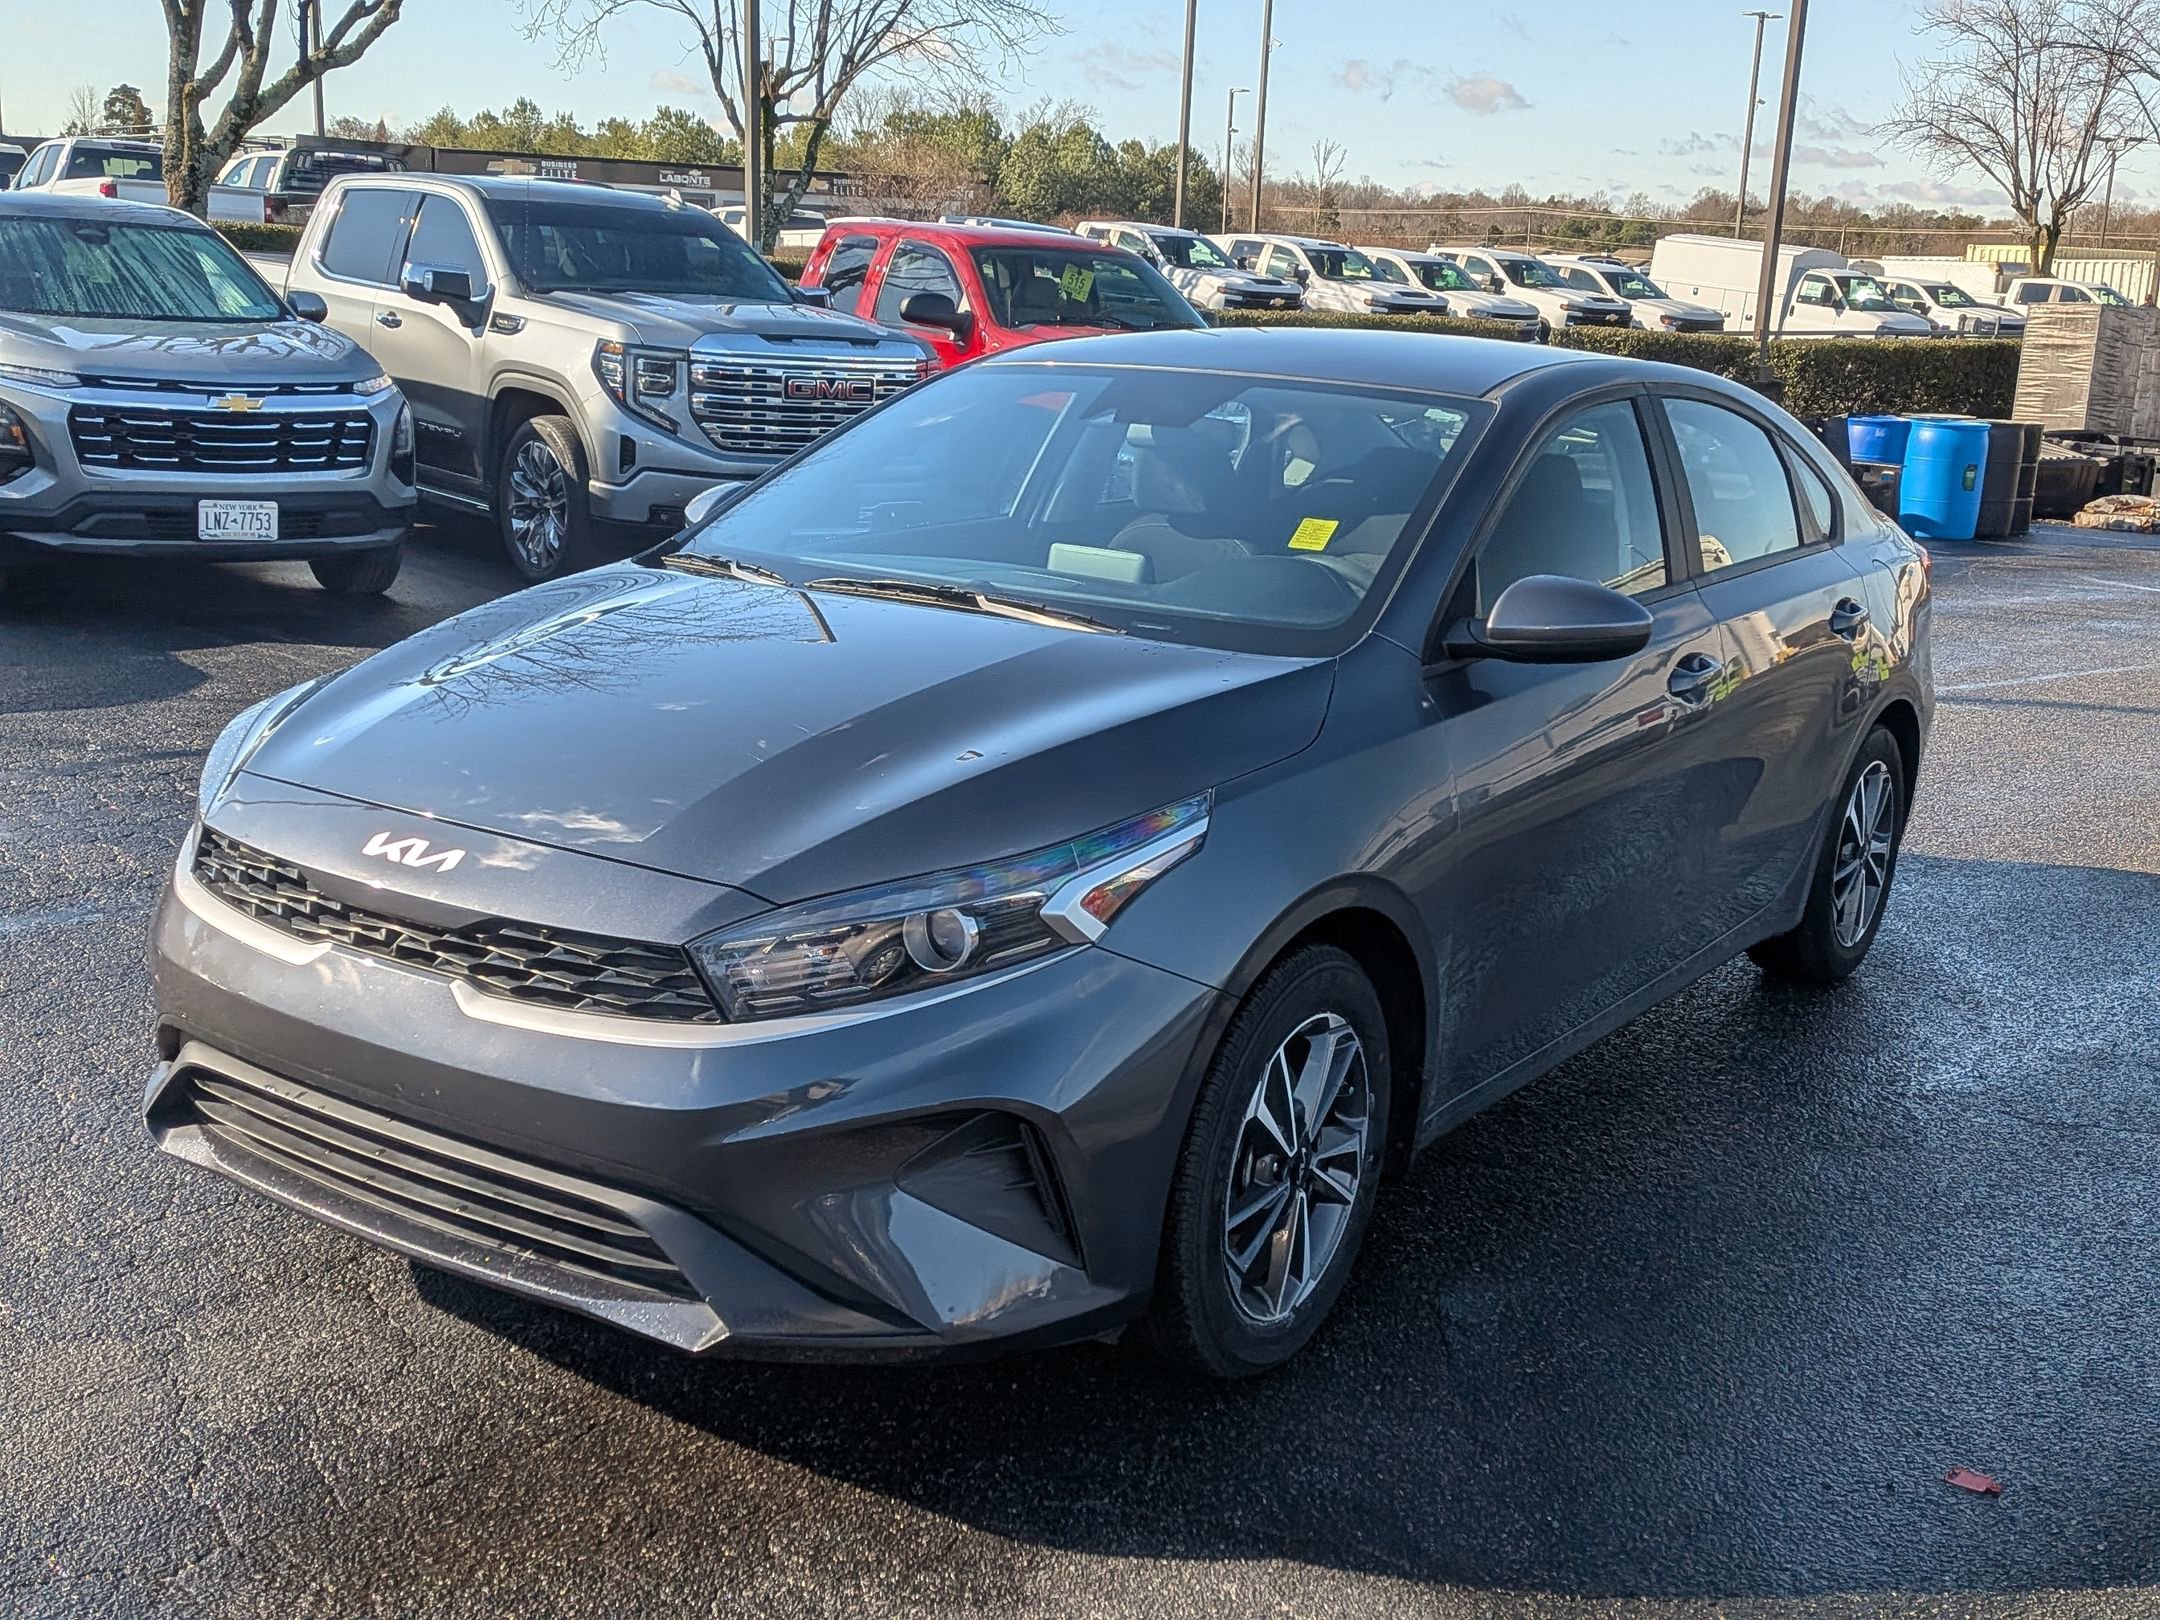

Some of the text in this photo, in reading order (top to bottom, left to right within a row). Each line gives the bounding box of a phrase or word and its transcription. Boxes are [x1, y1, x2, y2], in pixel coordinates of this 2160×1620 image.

[659, 173, 711, 185] LABONTE
[788, 379, 871, 399] GMC
[219, 503, 237, 511] NEW
[205, 511, 272, 531] LNZ 7753
[361, 831, 467, 873] KIA
